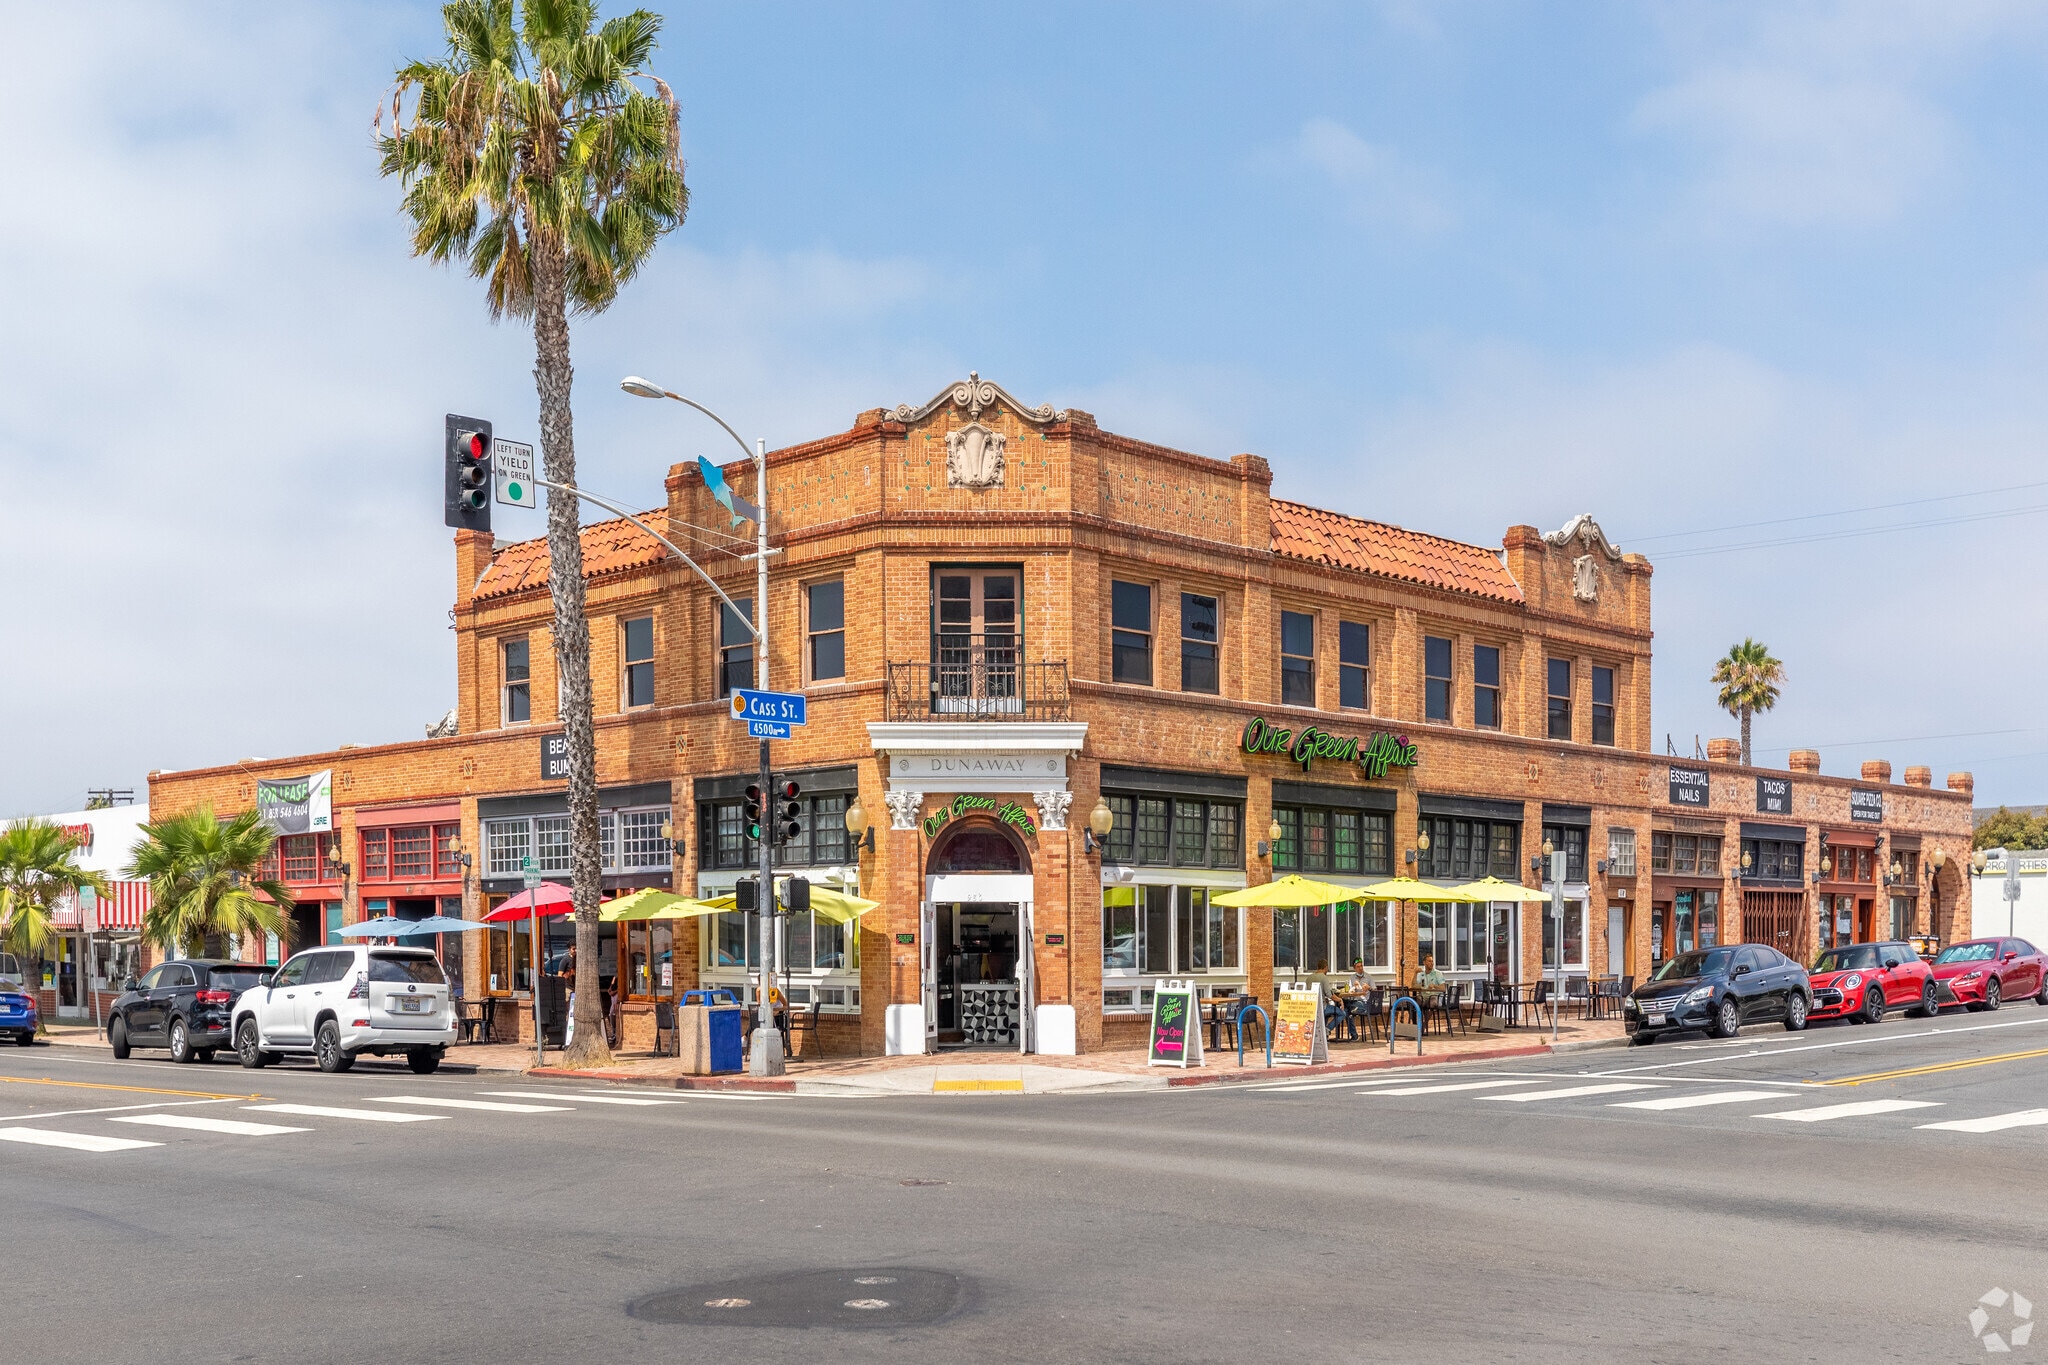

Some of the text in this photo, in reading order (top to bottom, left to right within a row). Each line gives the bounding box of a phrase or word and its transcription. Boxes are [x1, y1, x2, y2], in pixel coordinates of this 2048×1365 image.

[497, 444, 531, 457] LEFT TURN
[500, 456, 529, 470] YIELD
[498, 468, 531, 482] ON GREEN
[750, 697, 798, 719] CASS ST.
[753, 722, 774, 735] 4500
[931, 759, 1025, 771] DUNAWAY
[1670, 770, 1709, 787] ESSENTIAL
[258, 783, 309, 805] FOR LEASE
[1763, 781, 1786, 795] TACOS
[1679, 788, 1700, 803] NAILS
[279, 806, 292, 818] 546
[293, 804, 308, 817] 4604
[1767, 797, 1782, 811] MIMI
[951, 794, 995, 817] Green
[997, 801, 1036, 837] Affair
[524, 857, 530, 866] 2
[1985, 859, 2047, 871] PRORTIES
[1157, 1026, 1184, 1039] Now Open
